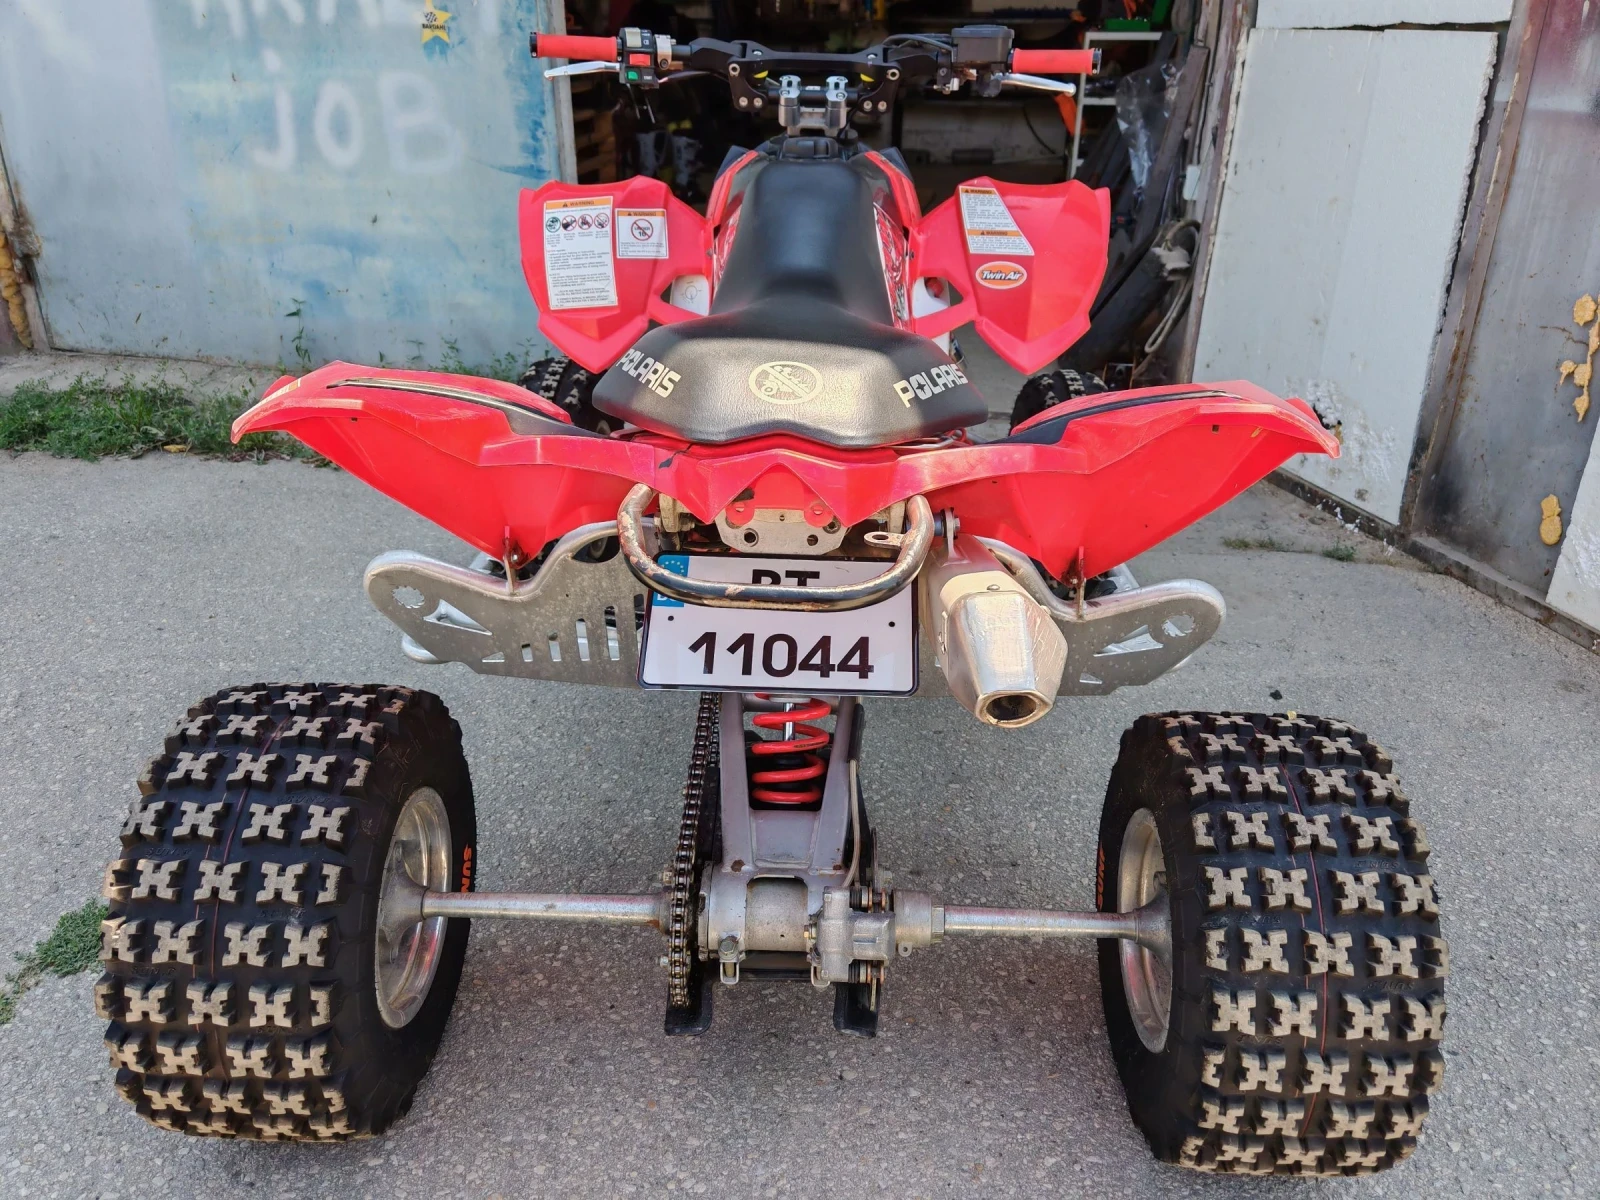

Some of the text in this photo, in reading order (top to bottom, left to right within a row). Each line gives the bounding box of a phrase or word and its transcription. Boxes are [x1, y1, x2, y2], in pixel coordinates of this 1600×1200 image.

[982, 270, 1023, 280] Twin Air
[616, 348, 682, 398] POLARIS
[893, 363, 969, 408] POLARIS
[688, 631, 874, 680] 11044
